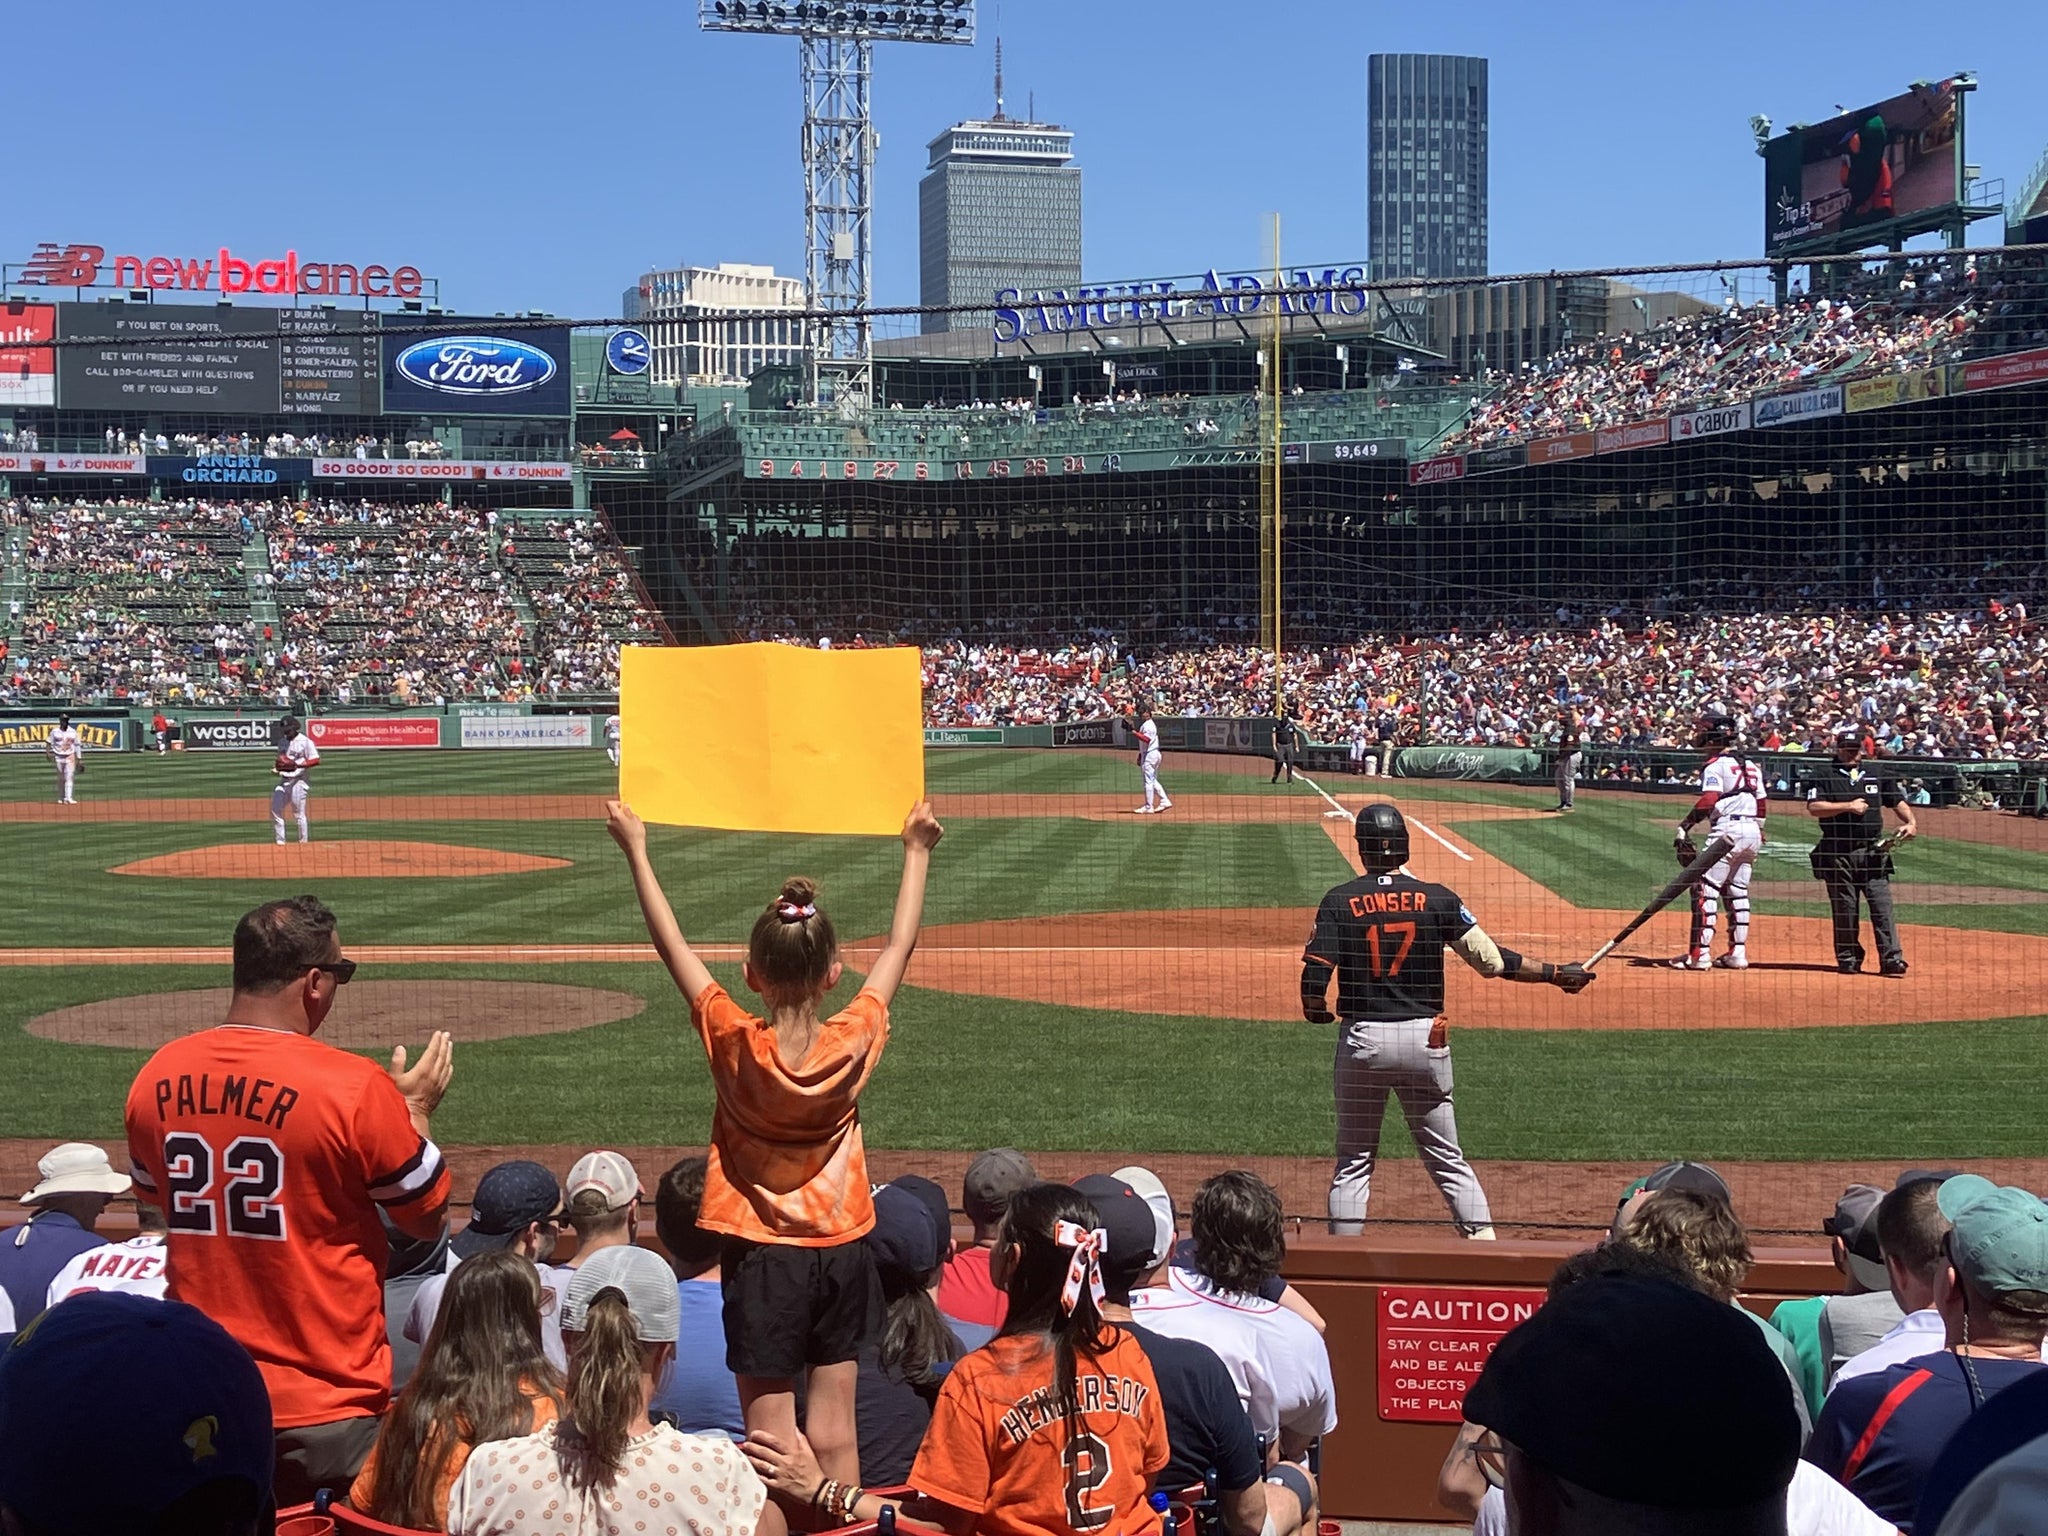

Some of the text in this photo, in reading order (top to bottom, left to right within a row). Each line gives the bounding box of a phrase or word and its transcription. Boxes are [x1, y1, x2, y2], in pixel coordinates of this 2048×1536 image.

[1785, 206, 1798, 224] Tip
[993, 268, 1370, 343] SAMUEL ADAMS
[294, 310, 326, 319] DURAN
[117, 321, 222, 333] IF YOU BET ON SPORTS,
[235, 340, 269, 349] SOCIAL
[295, 346, 350, 355] CONTRERAS
[101, 352, 239, 364] BET WITH FRIENDS AND FAMILY
[428, 345, 524, 384] Ford
[86, 367, 109, 377] CALL
[182, 370, 203, 379] WITH
[205, 370, 254, 380] QUESTIONS
[295, 369, 354, 378] MONASTERIO
[122, 384, 219, 395] OR IF YOU NEED HELP
[296, 404, 322, 412] WONG
[1335, 444, 1378, 459] $9,649
[84, 460, 136, 470] DUNKIN'
[196, 454, 262, 469] ANGRY
[760, 460, 774, 476] 9
[790, 460, 803, 476] 4
[820, 461, 828, 479] 1
[873, 461, 899, 479] 27
[915, 462, 928, 480] 6
[954, 461, 973, 479] 14
[987, 459, 1010, 477] 45
[1024, 458, 1048, 476] 26
[1063, 455, 1086, 473] 34
[1101, 454, 1121, 473] 42
[182, 468, 278, 484] ORCHARD
[322, 464, 466, 476] SO GOOD! SO GOOD!
[518, 467, 566, 478] DUNKIN'
[76, 723, 118, 746] CITY
[193, 720, 271, 740] wasabi
[327, 725, 434, 736] Harvard Pilgrim Health Care
[464, 729, 563, 738] BANK OF AMERICA
[1064, 724, 1106, 744] jordans
[1348, 892, 1426, 918] COWSER
[1366, 921, 1416, 978] 17
[156, 1074, 300, 1130] PALMER
[164, 1131, 288, 1242] 22
[78, 1253, 166, 1280] MAYE
[1387, 1339, 1422, 1351] STAY
[1429, 1340, 1480, 1352] CLEAR
[1390, 1359, 1484, 1373] AND BE ALE
[1395, 1378, 1466, 1392] OBJECTS
[1391, 1398, 1421, 1409] THE
[1061, 1432, 1116, 1532] 2
